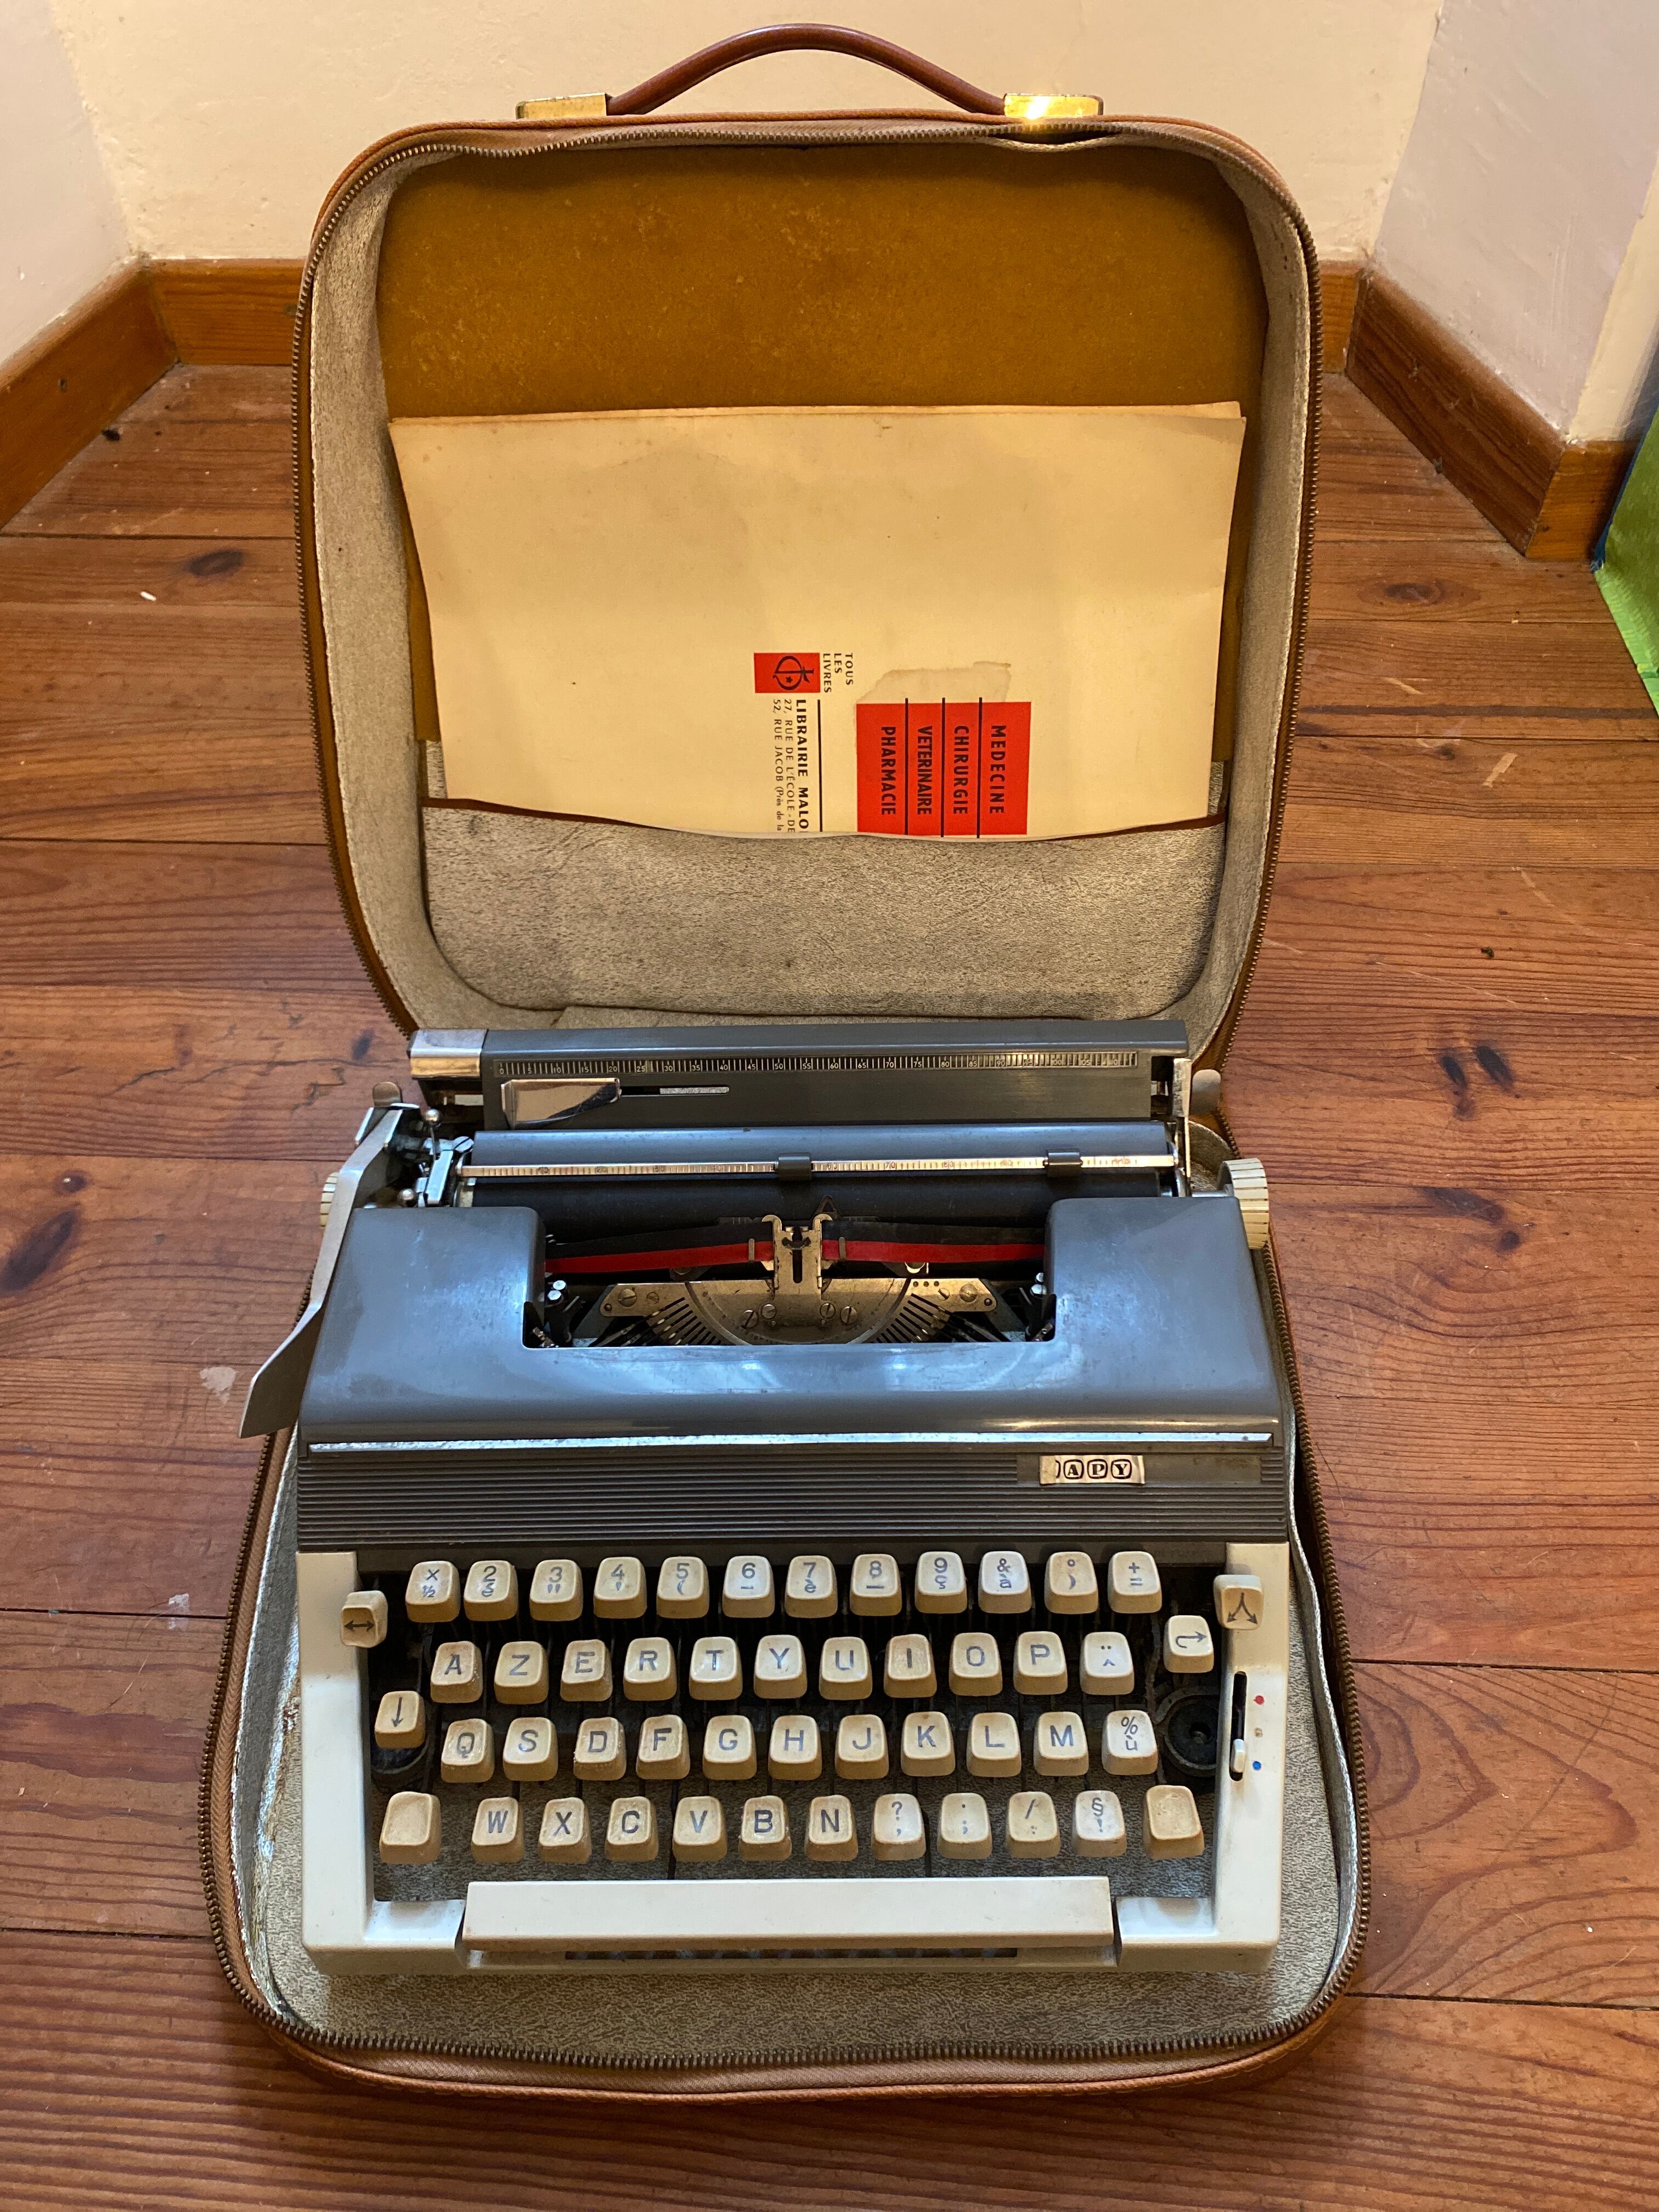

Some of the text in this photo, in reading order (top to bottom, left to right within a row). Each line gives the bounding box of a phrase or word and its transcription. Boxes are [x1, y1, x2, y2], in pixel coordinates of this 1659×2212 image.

[823, 653, 832, 693] LIVRES
[834, 653, 842, 674] LES
[774, 719, 782, 741] RUE
[785, 720, 793, 741] RUE
[775, 747, 783, 781] JACOB
[786, 747, 794, 760] DE
[796, 699, 809, 833] LIBRAIRIE MALO
[881, 726, 896, 815] PHARMACIE
[917, 726, 932, 815] VETERINAIRE
[953, 726, 969, 815] CHIRURGIE
[990, 725, 1006, 814] MEDECINE
[775, 787, 784, 806] (Près
[777, 811, 784, 820] de
[1056, 1458, 1132, 1480] APY
[482, 1565, 496, 1582] 2
[549, 1566, 563, 1583] 3
[611, 1564, 625, 1580] 4
[676, 1562, 689, 1580] 5
[742, 1562, 756, 1579] 6
[803, 1562, 816, 1578] 7
[869, 1560, 882, 1579] 8
[934, 1557, 947, 1573] 9
[997, 1558, 1011, 1572] &
[444, 1654, 462, 1675] A
[509, 1655, 531, 1675] Z
[575, 1651, 596, 1673] E
[639, 1650, 657, 1671] R
[706, 1650, 724, 1671] T
[769, 1647, 790, 1669] Y
[835, 1650, 855, 1671] U
[906, 1647, 913, 1668] I
[966, 1646, 985, 1667] O
[1030, 1644, 1051, 1666] P
[917, 1725, 937, 1748] K
[985, 1725, 1005, 1747] L
[1049, 1725, 1074, 1747] M
[1121, 1716, 1138, 1735] %
[456, 1732, 475, 1758] Q
[518, 1729, 539, 1752] S
[588, 1731, 607, 1753] D
[653, 1728, 672, 1751] F
[718, 1728, 738, 1751] G
[783, 1729, 804, 1751] H
[852, 1727, 872, 1750] J
[891, 1801, 903, 1821] ?
[1091, 1797, 1104, 1816] §
[488, 1810, 508, 1833] W
[553, 1811, 573, 1836] X
[621, 1810, 639, 1834] C
[689, 1810, 708, 1833] V
[754, 1809, 773, 1833] B
[820, 1809, 839, 1832] N
